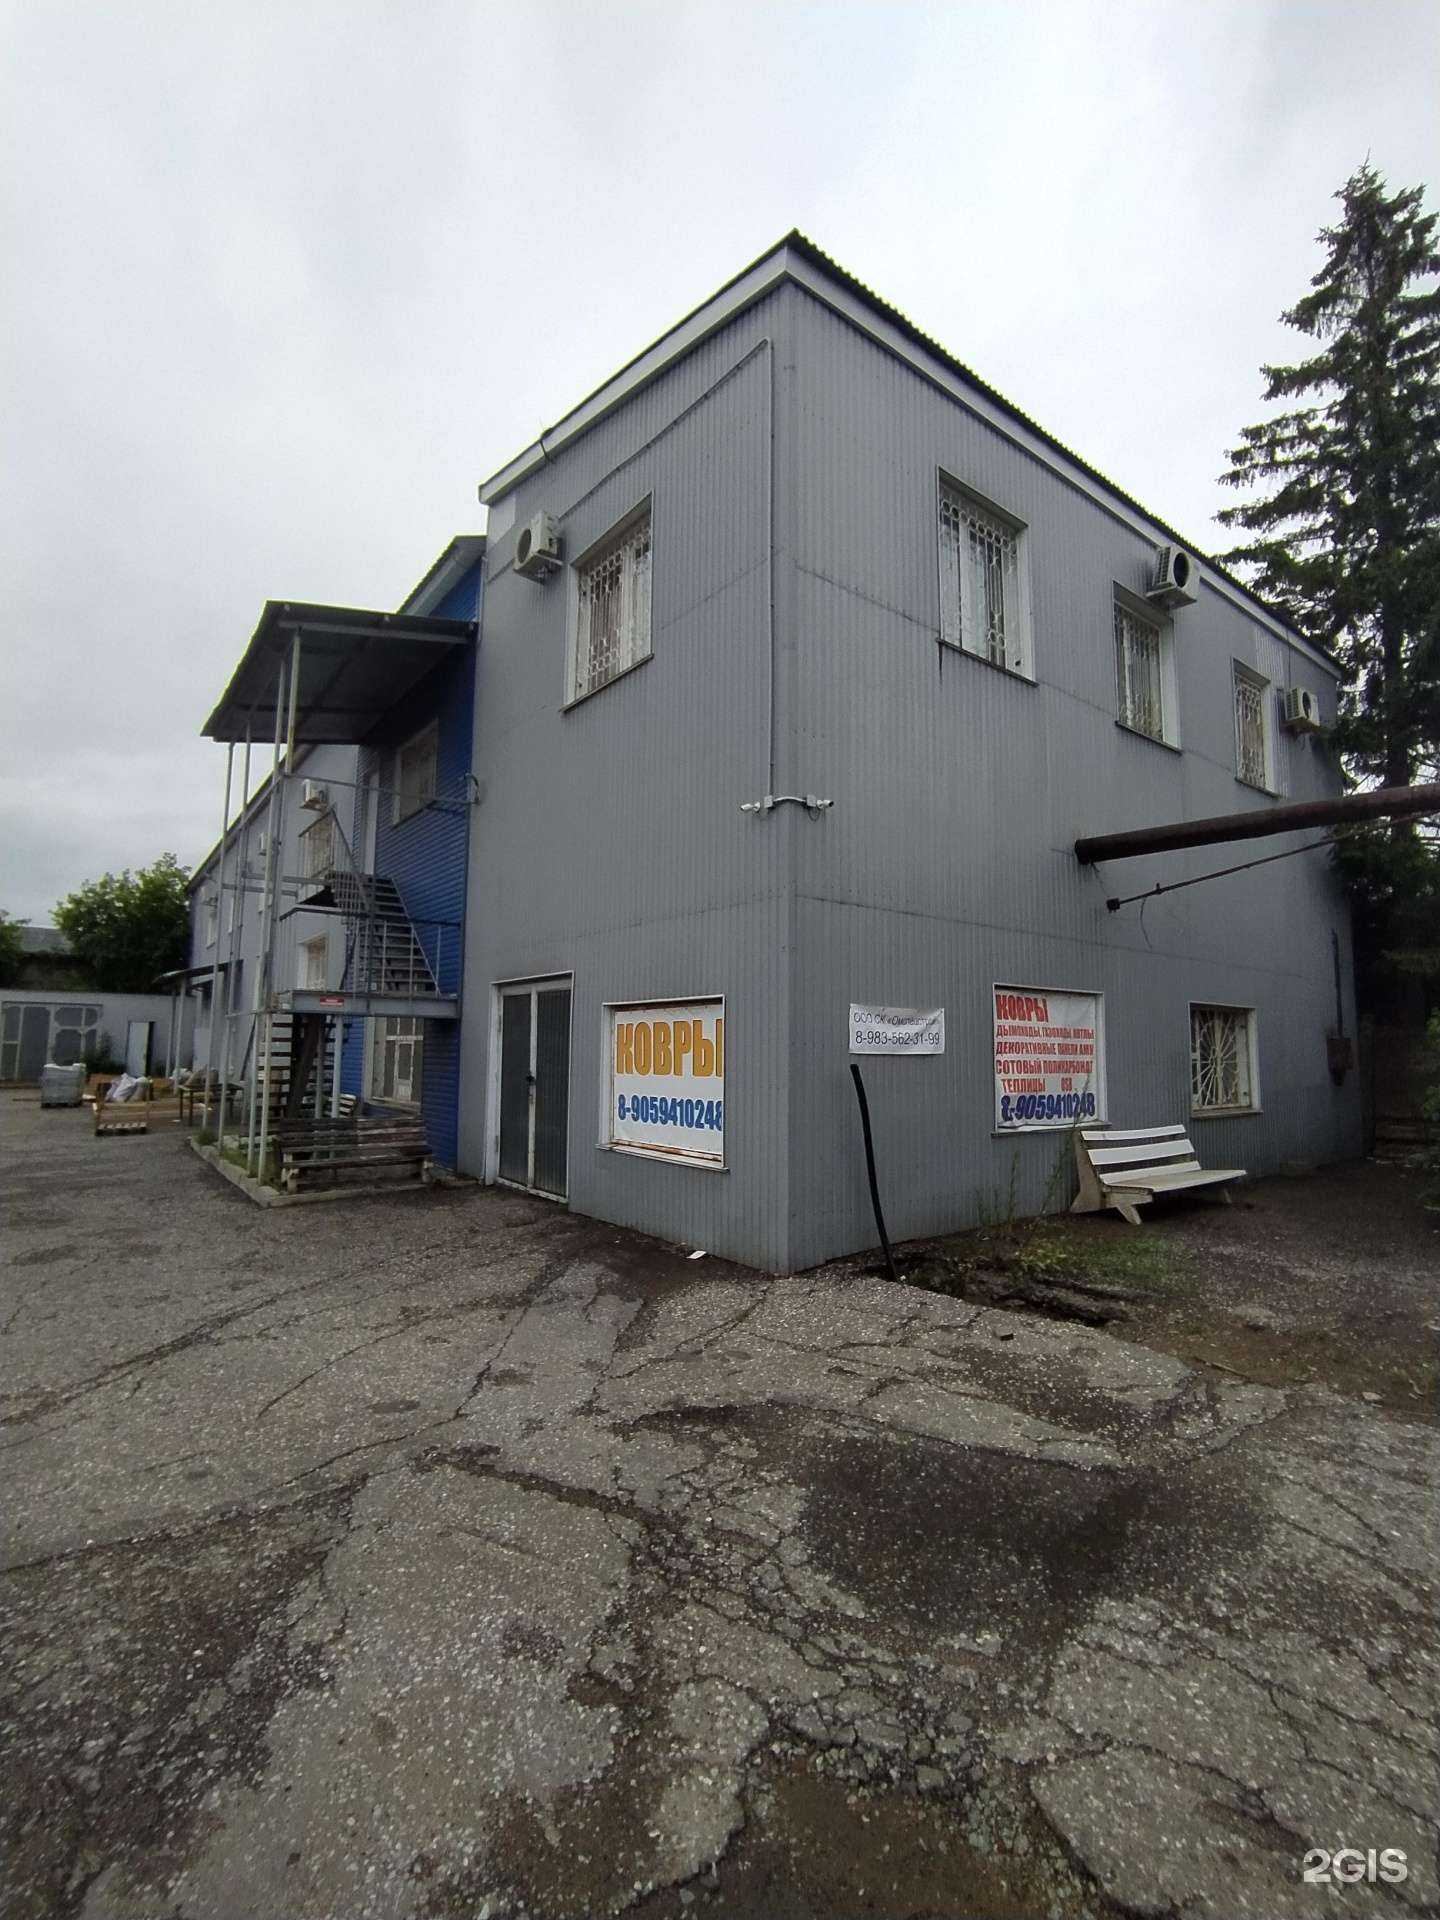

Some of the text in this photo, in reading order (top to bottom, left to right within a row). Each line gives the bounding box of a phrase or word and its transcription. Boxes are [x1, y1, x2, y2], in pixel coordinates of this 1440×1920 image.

[996, 994, 1049, 1022] КОВРЫ
[855, 1030, 940, 1045] 8-983-562-31-99
[616, 1018, 723, 1078] КОВРЫ
[996, 1042, 1056, 1055] ДЕКОРАТИВНЫЕ
[996, 1060, 1093, 1075] СОТОВЫЙ ПОЛИКАРБОНАТ
[1001, 1078, 1046, 1093] ТЕПЛИЦЫ
